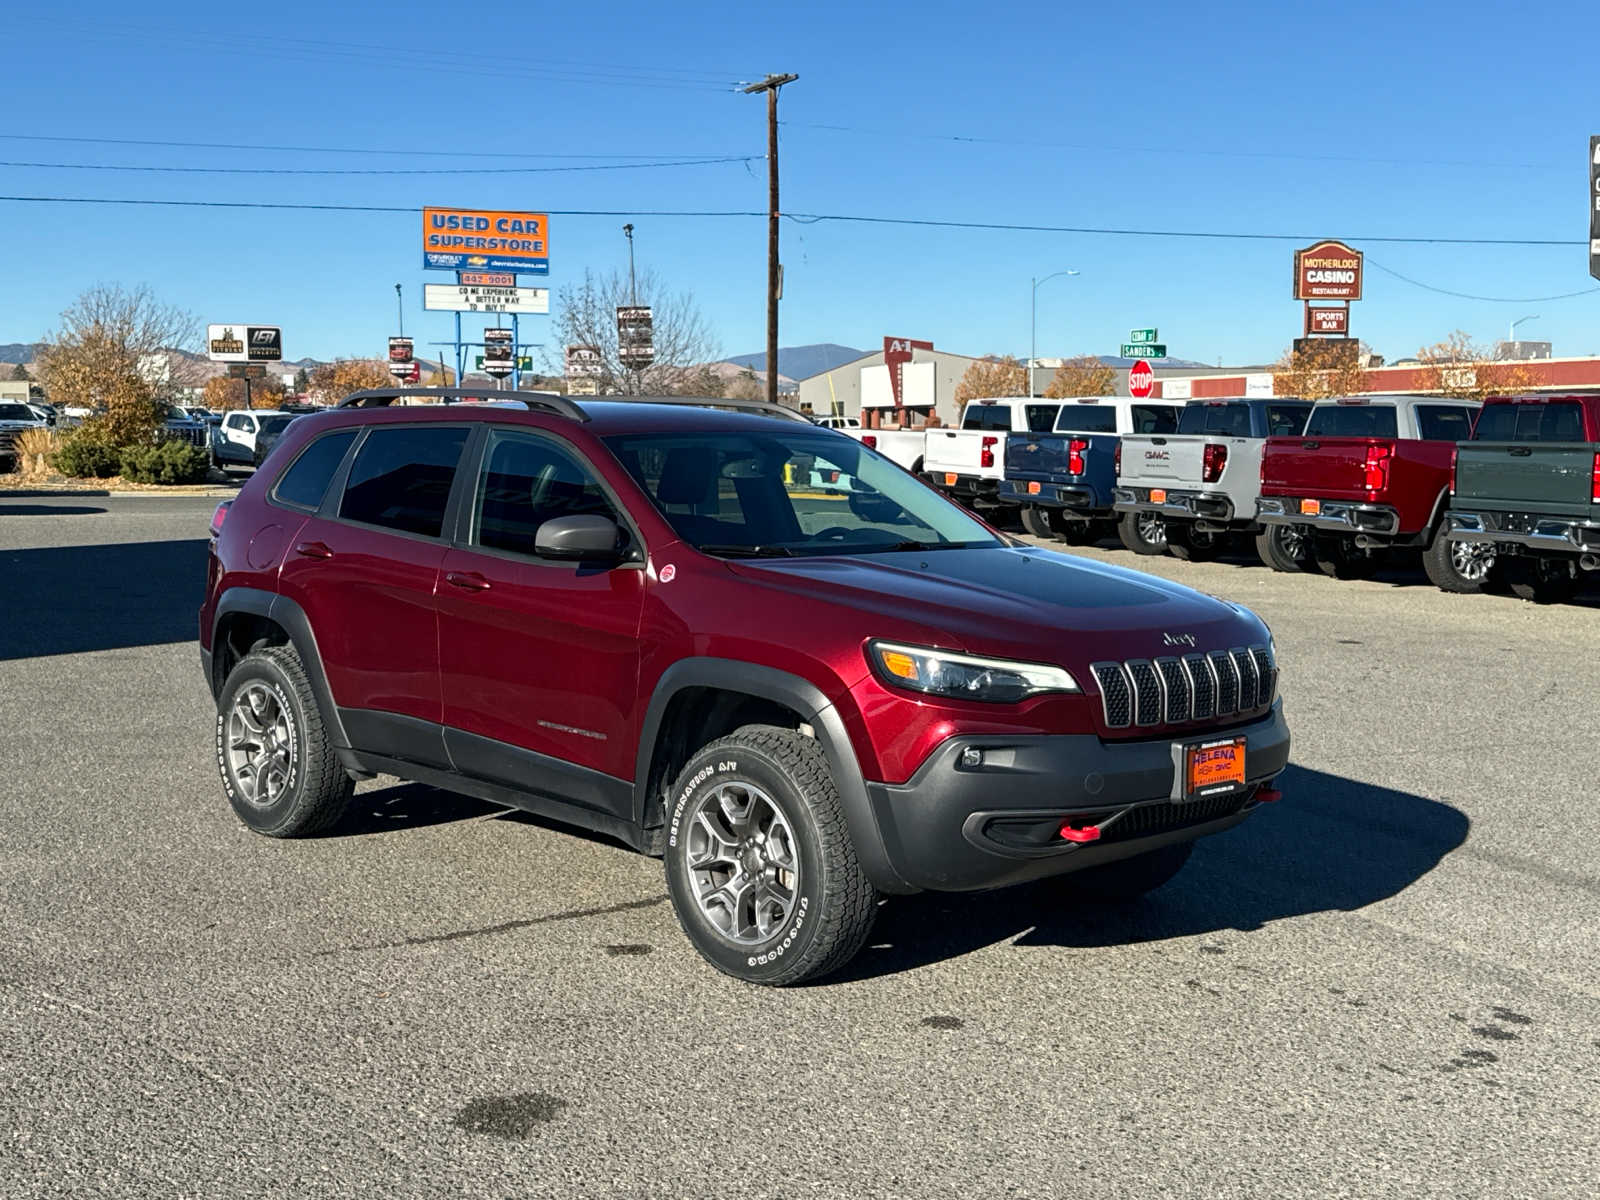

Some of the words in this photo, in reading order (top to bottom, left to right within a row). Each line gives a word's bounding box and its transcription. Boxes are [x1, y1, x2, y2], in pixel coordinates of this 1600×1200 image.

[431, 213, 490, 231] USED
[495, 217, 540, 235] CAR
[428, 234, 544, 253] SUPERSTORE
[1304, 258, 1359, 269] MOTHERLODE
[1306, 270, 1355, 284] CASINO
[1312, 287, 1350, 295] RESTAURANT
[1315, 312, 1344, 321] SPORTS
[1321, 320, 1338, 329] BAR
[889, 339, 912, 353] A-1
[1125, 346, 1156, 357] SANDERS
[1130, 372, 1152, 390] STOP
[1144, 451, 1170, 460] GMC
[1163, 632, 1196, 648] Jeep
[1192, 748, 1237, 766] HELENA
[669, 764, 715, 848] DESTINATION
[718, 760, 738, 772] A/T
